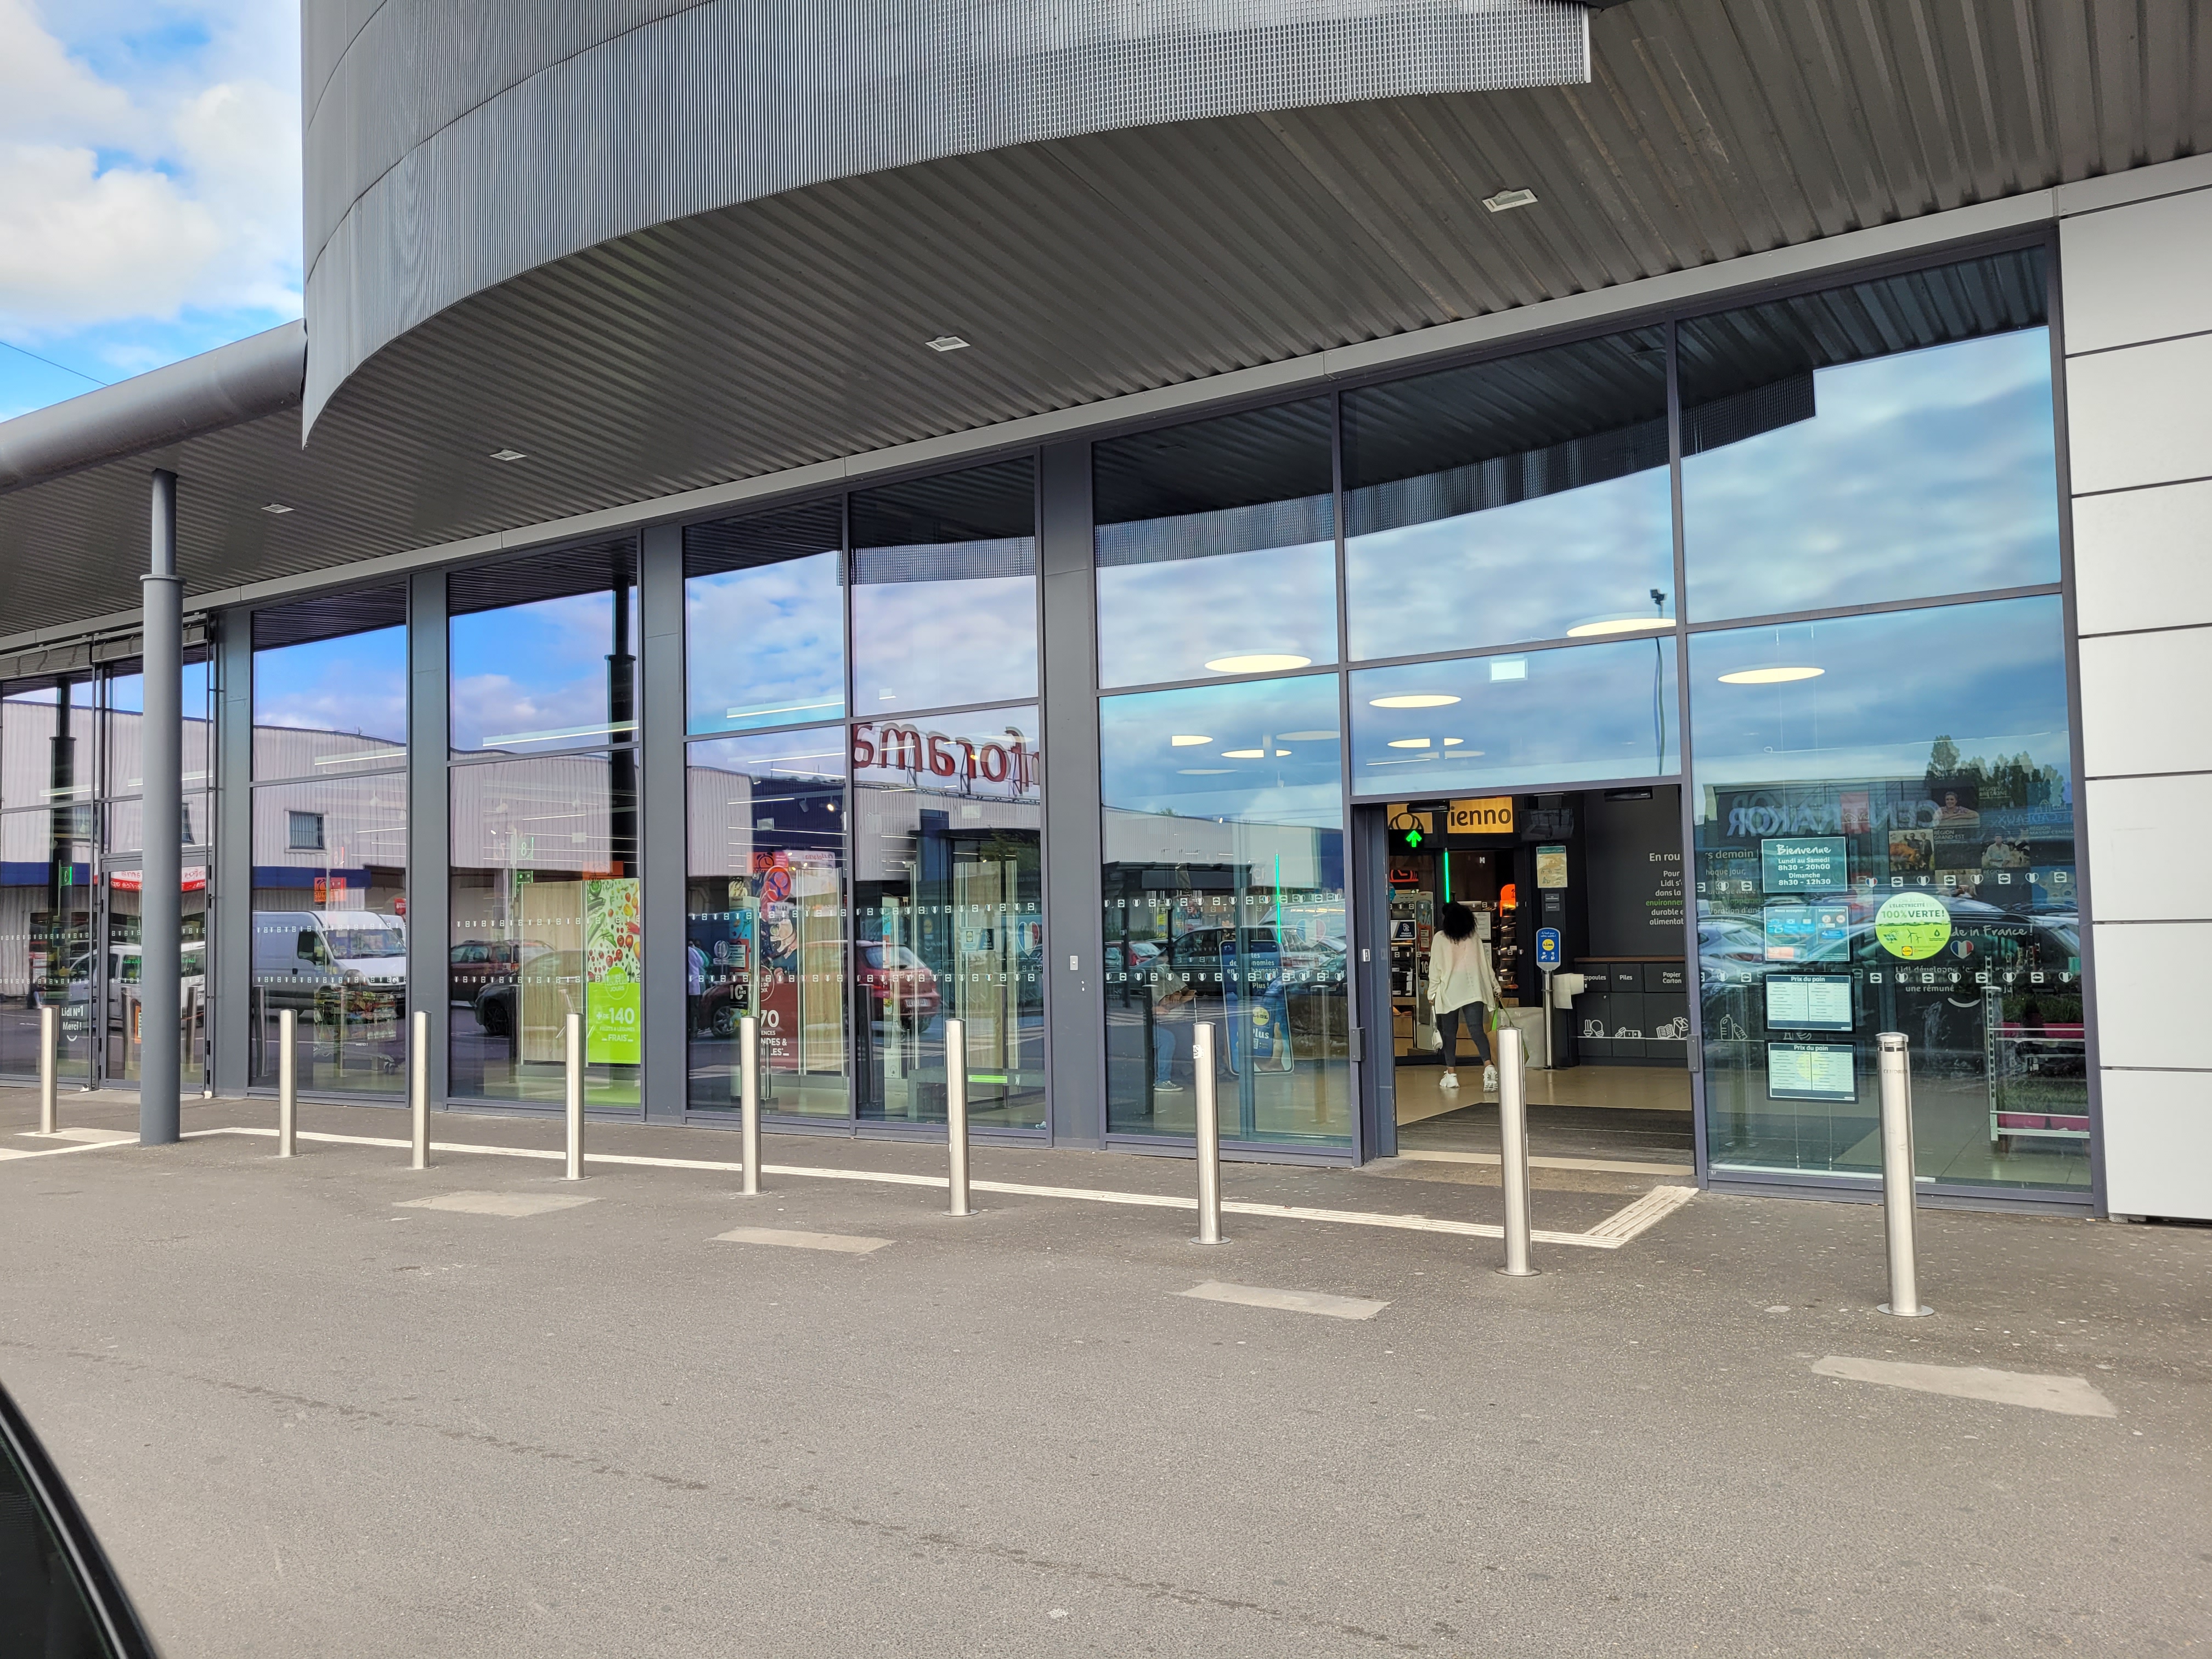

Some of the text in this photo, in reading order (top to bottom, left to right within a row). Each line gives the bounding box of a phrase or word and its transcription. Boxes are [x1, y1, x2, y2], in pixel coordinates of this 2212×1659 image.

[1449, 806, 1511, 827] ienno
[521, 842, 527, 856] 8
[1716, 849, 1753, 859] demain
[1776, 844, 1832, 855] Bienvenue
[1649, 853, 1661, 861] En
[1881, 910, 1907, 918] 100%
[1649, 917, 1684, 926] alimentat
[1951, 927, 1968, 936] de
[1970, 926, 1980, 937] in
[1982, 925, 2027, 936] France
[61, 1005, 83, 1017] Lidl N°1
[609, 1007, 635, 1024] 140
[63, 1022, 79, 1031] Merci
[782, 1038, 787, 1046] &
